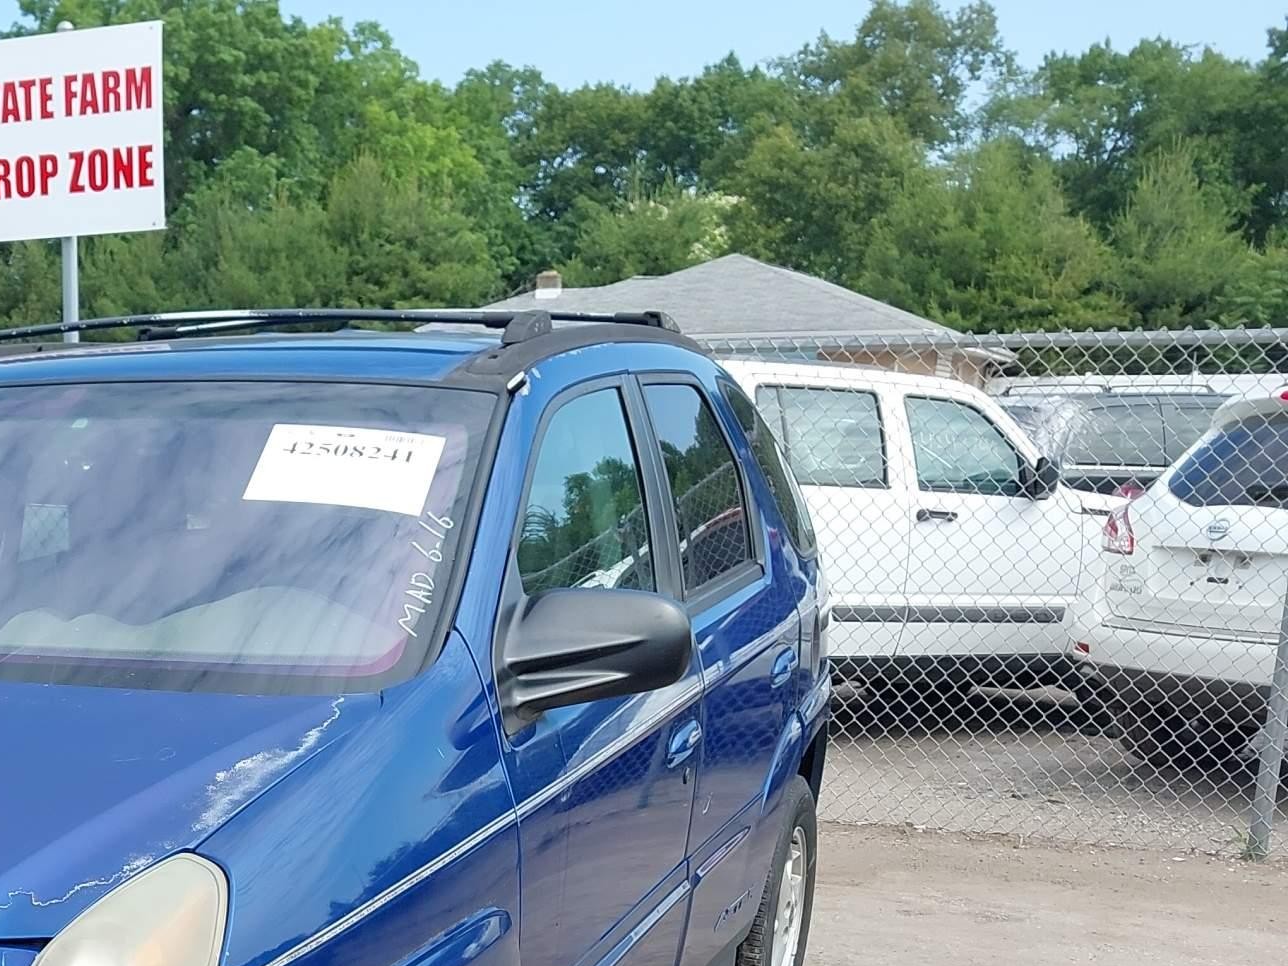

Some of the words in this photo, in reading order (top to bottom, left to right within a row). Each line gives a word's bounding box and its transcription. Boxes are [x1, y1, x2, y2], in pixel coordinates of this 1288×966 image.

[64, 66, 152, 118] FARM
[68, 144, 154, 193] ZONE
[283, 441, 413, 463] 42508241
[410, 511, 454, 562] 6-16
[398, 572, 435, 637] MAD
